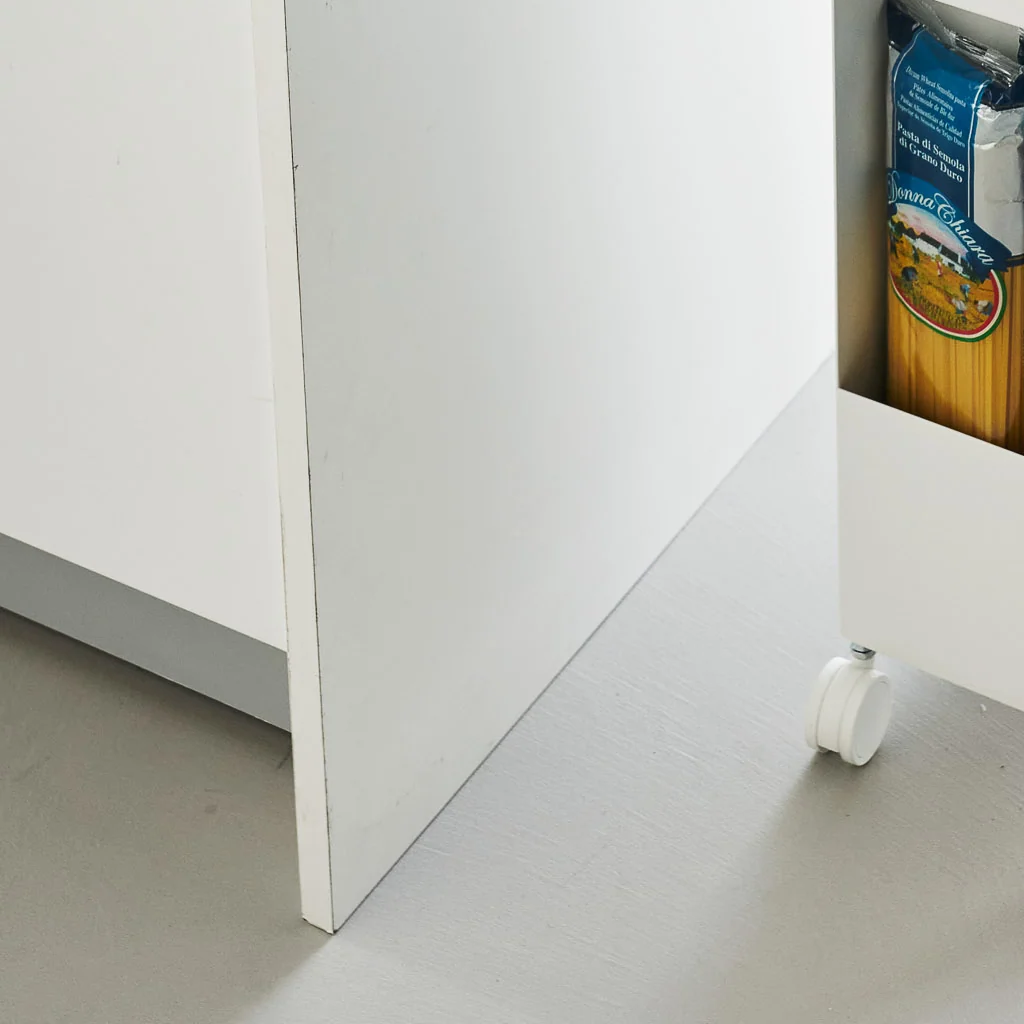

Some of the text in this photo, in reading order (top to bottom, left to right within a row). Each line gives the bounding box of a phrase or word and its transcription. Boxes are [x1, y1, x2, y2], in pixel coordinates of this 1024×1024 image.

[920, 73, 936, 89] Wheat
[936, 83, 955, 101] Semolina
[954, 95, 967, 108] pasta
[933, 104, 940, 112] de
[935, 125, 942, 134] de
[941, 129, 953, 143] Trigo
[953, 137, 966, 149] Duro
[938, 119, 945, 128] de
[944, 120, 963, 138] Calidad
[897, 121, 966, 173] Pasta di Semola
[899, 137, 963, 184] di Grano Duro
[887, 170, 995, 266] Donna Chiara
